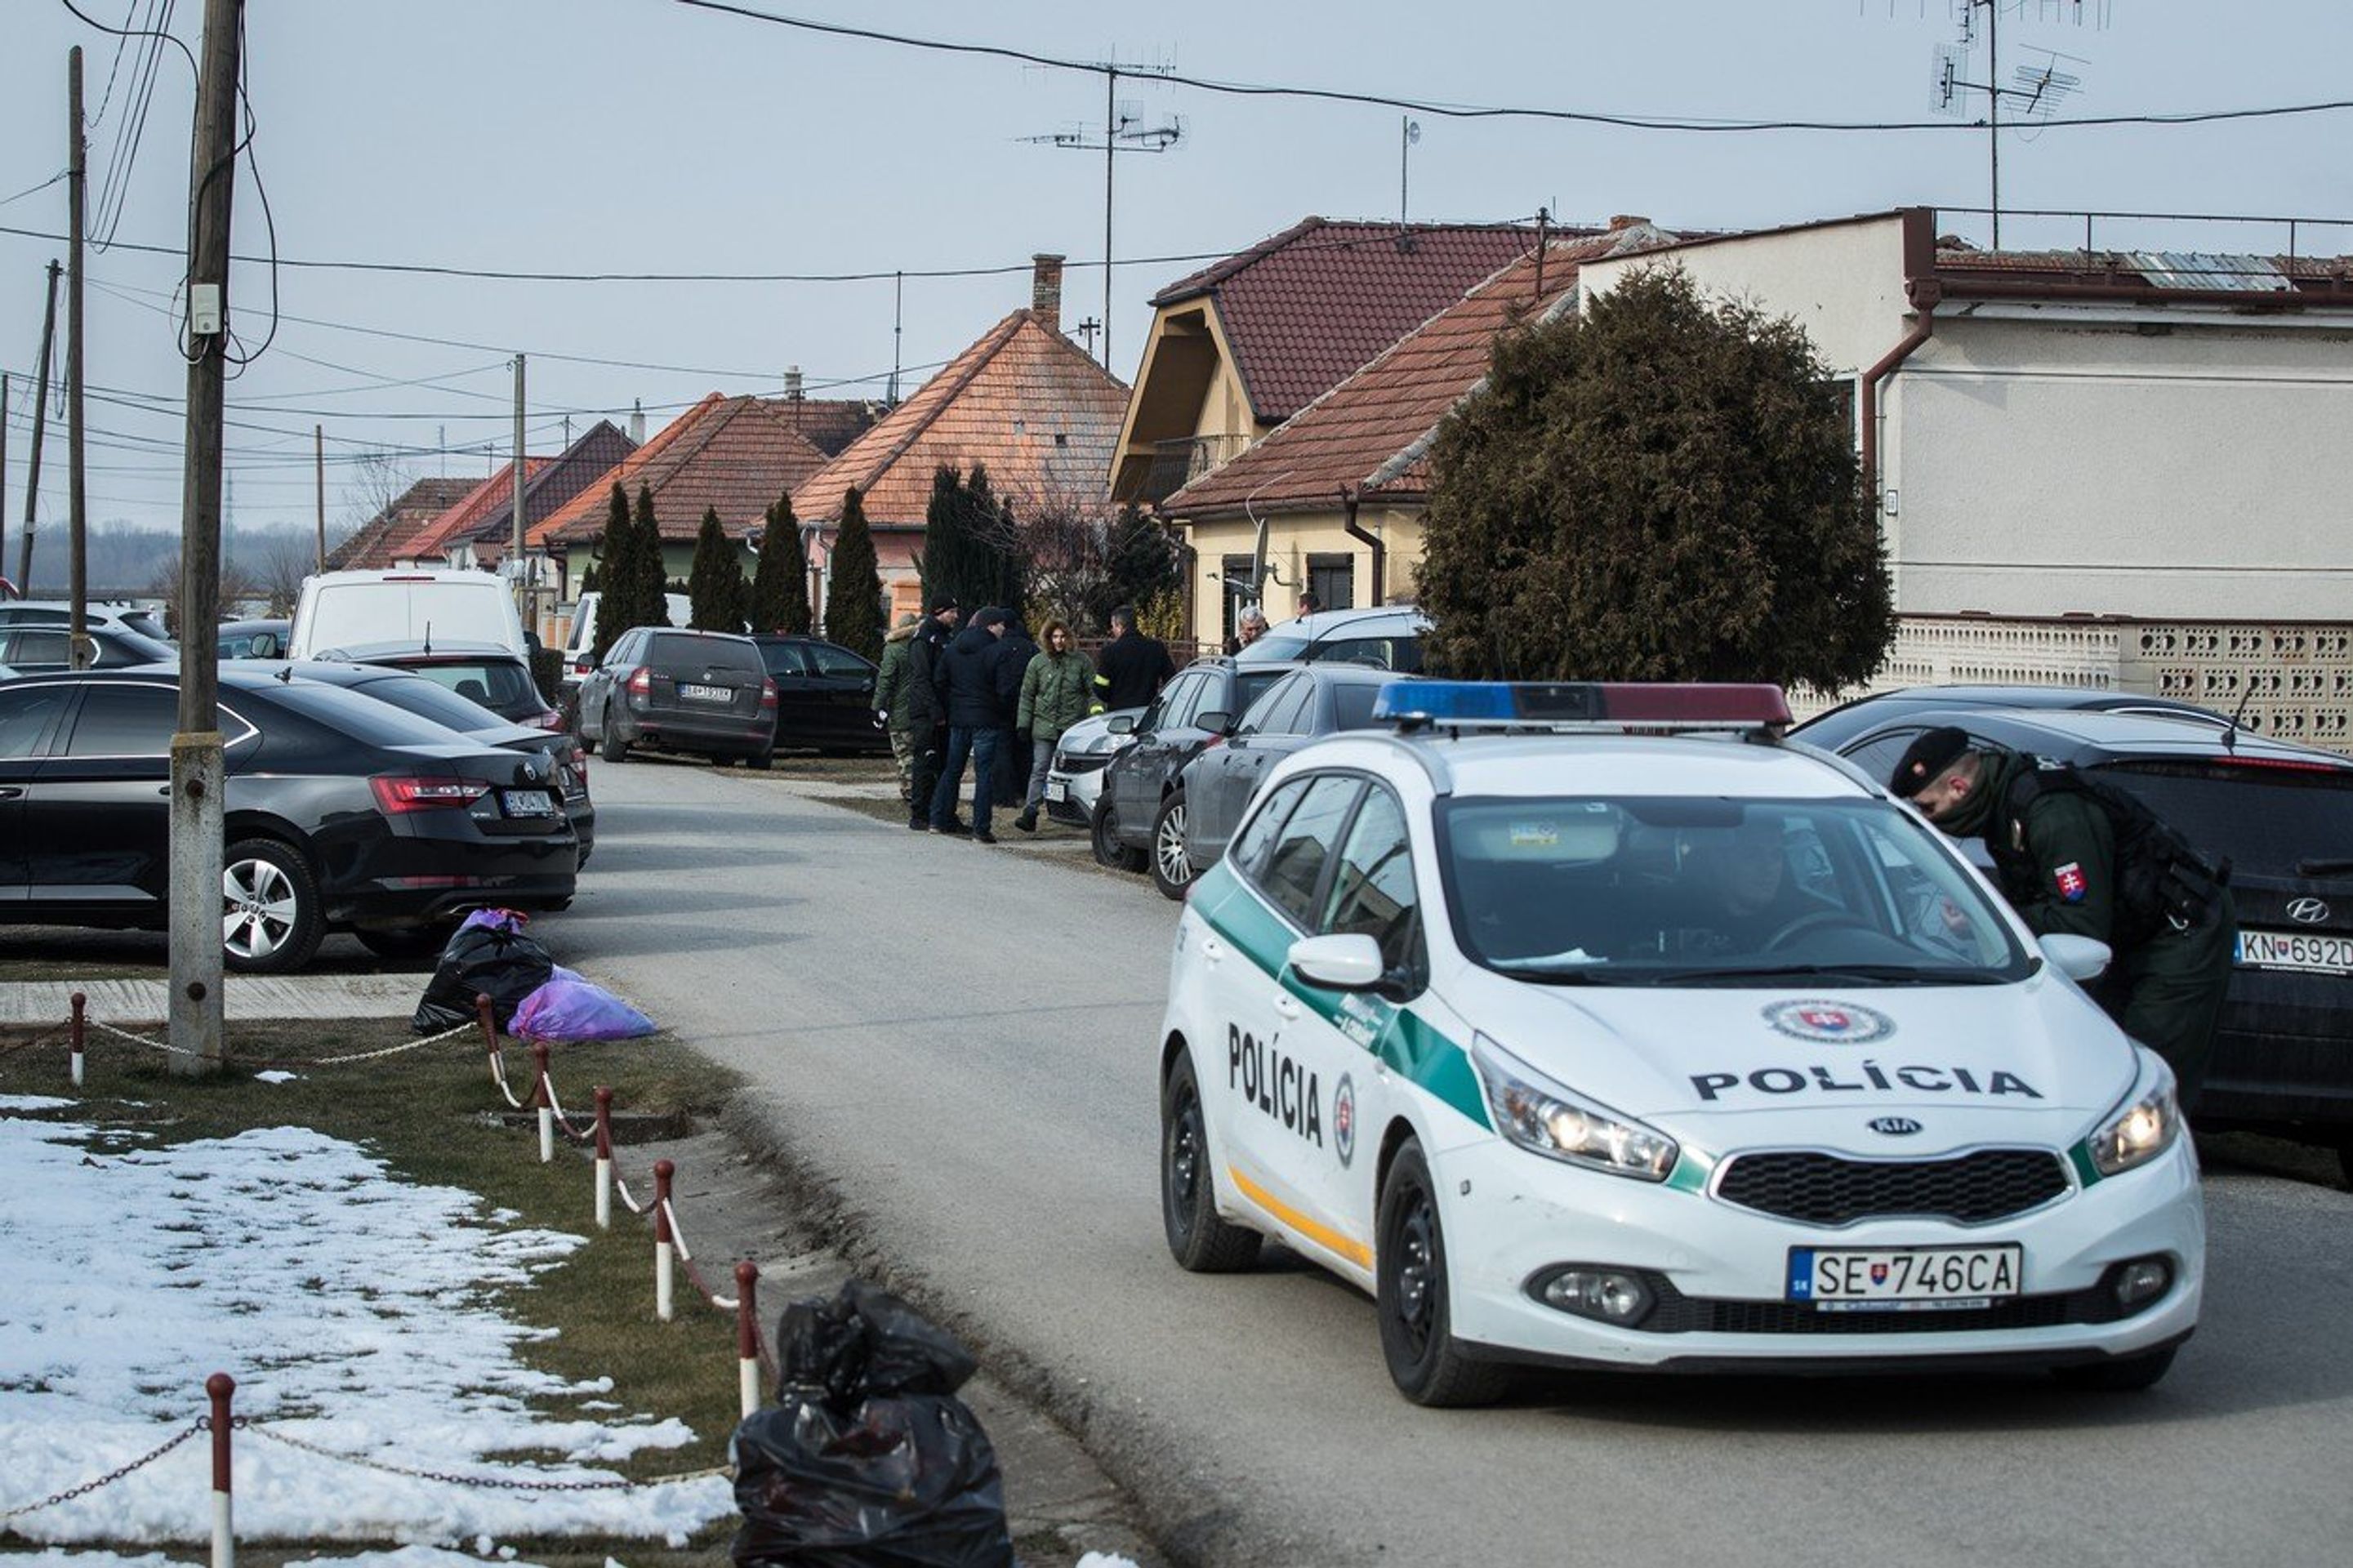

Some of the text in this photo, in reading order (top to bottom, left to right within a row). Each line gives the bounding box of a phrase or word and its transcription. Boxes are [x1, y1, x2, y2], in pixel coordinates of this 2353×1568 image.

[2244, 933, 2353, 966] KN 692D
[1228, 1022, 1323, 1148] POLÍCIA
[1689, 1059, 2045, 1101] POLÍCIA
[1876, 1117, 1918, 1131] KIA
[1818, 1253, 2012, 1294] SE 746CA
